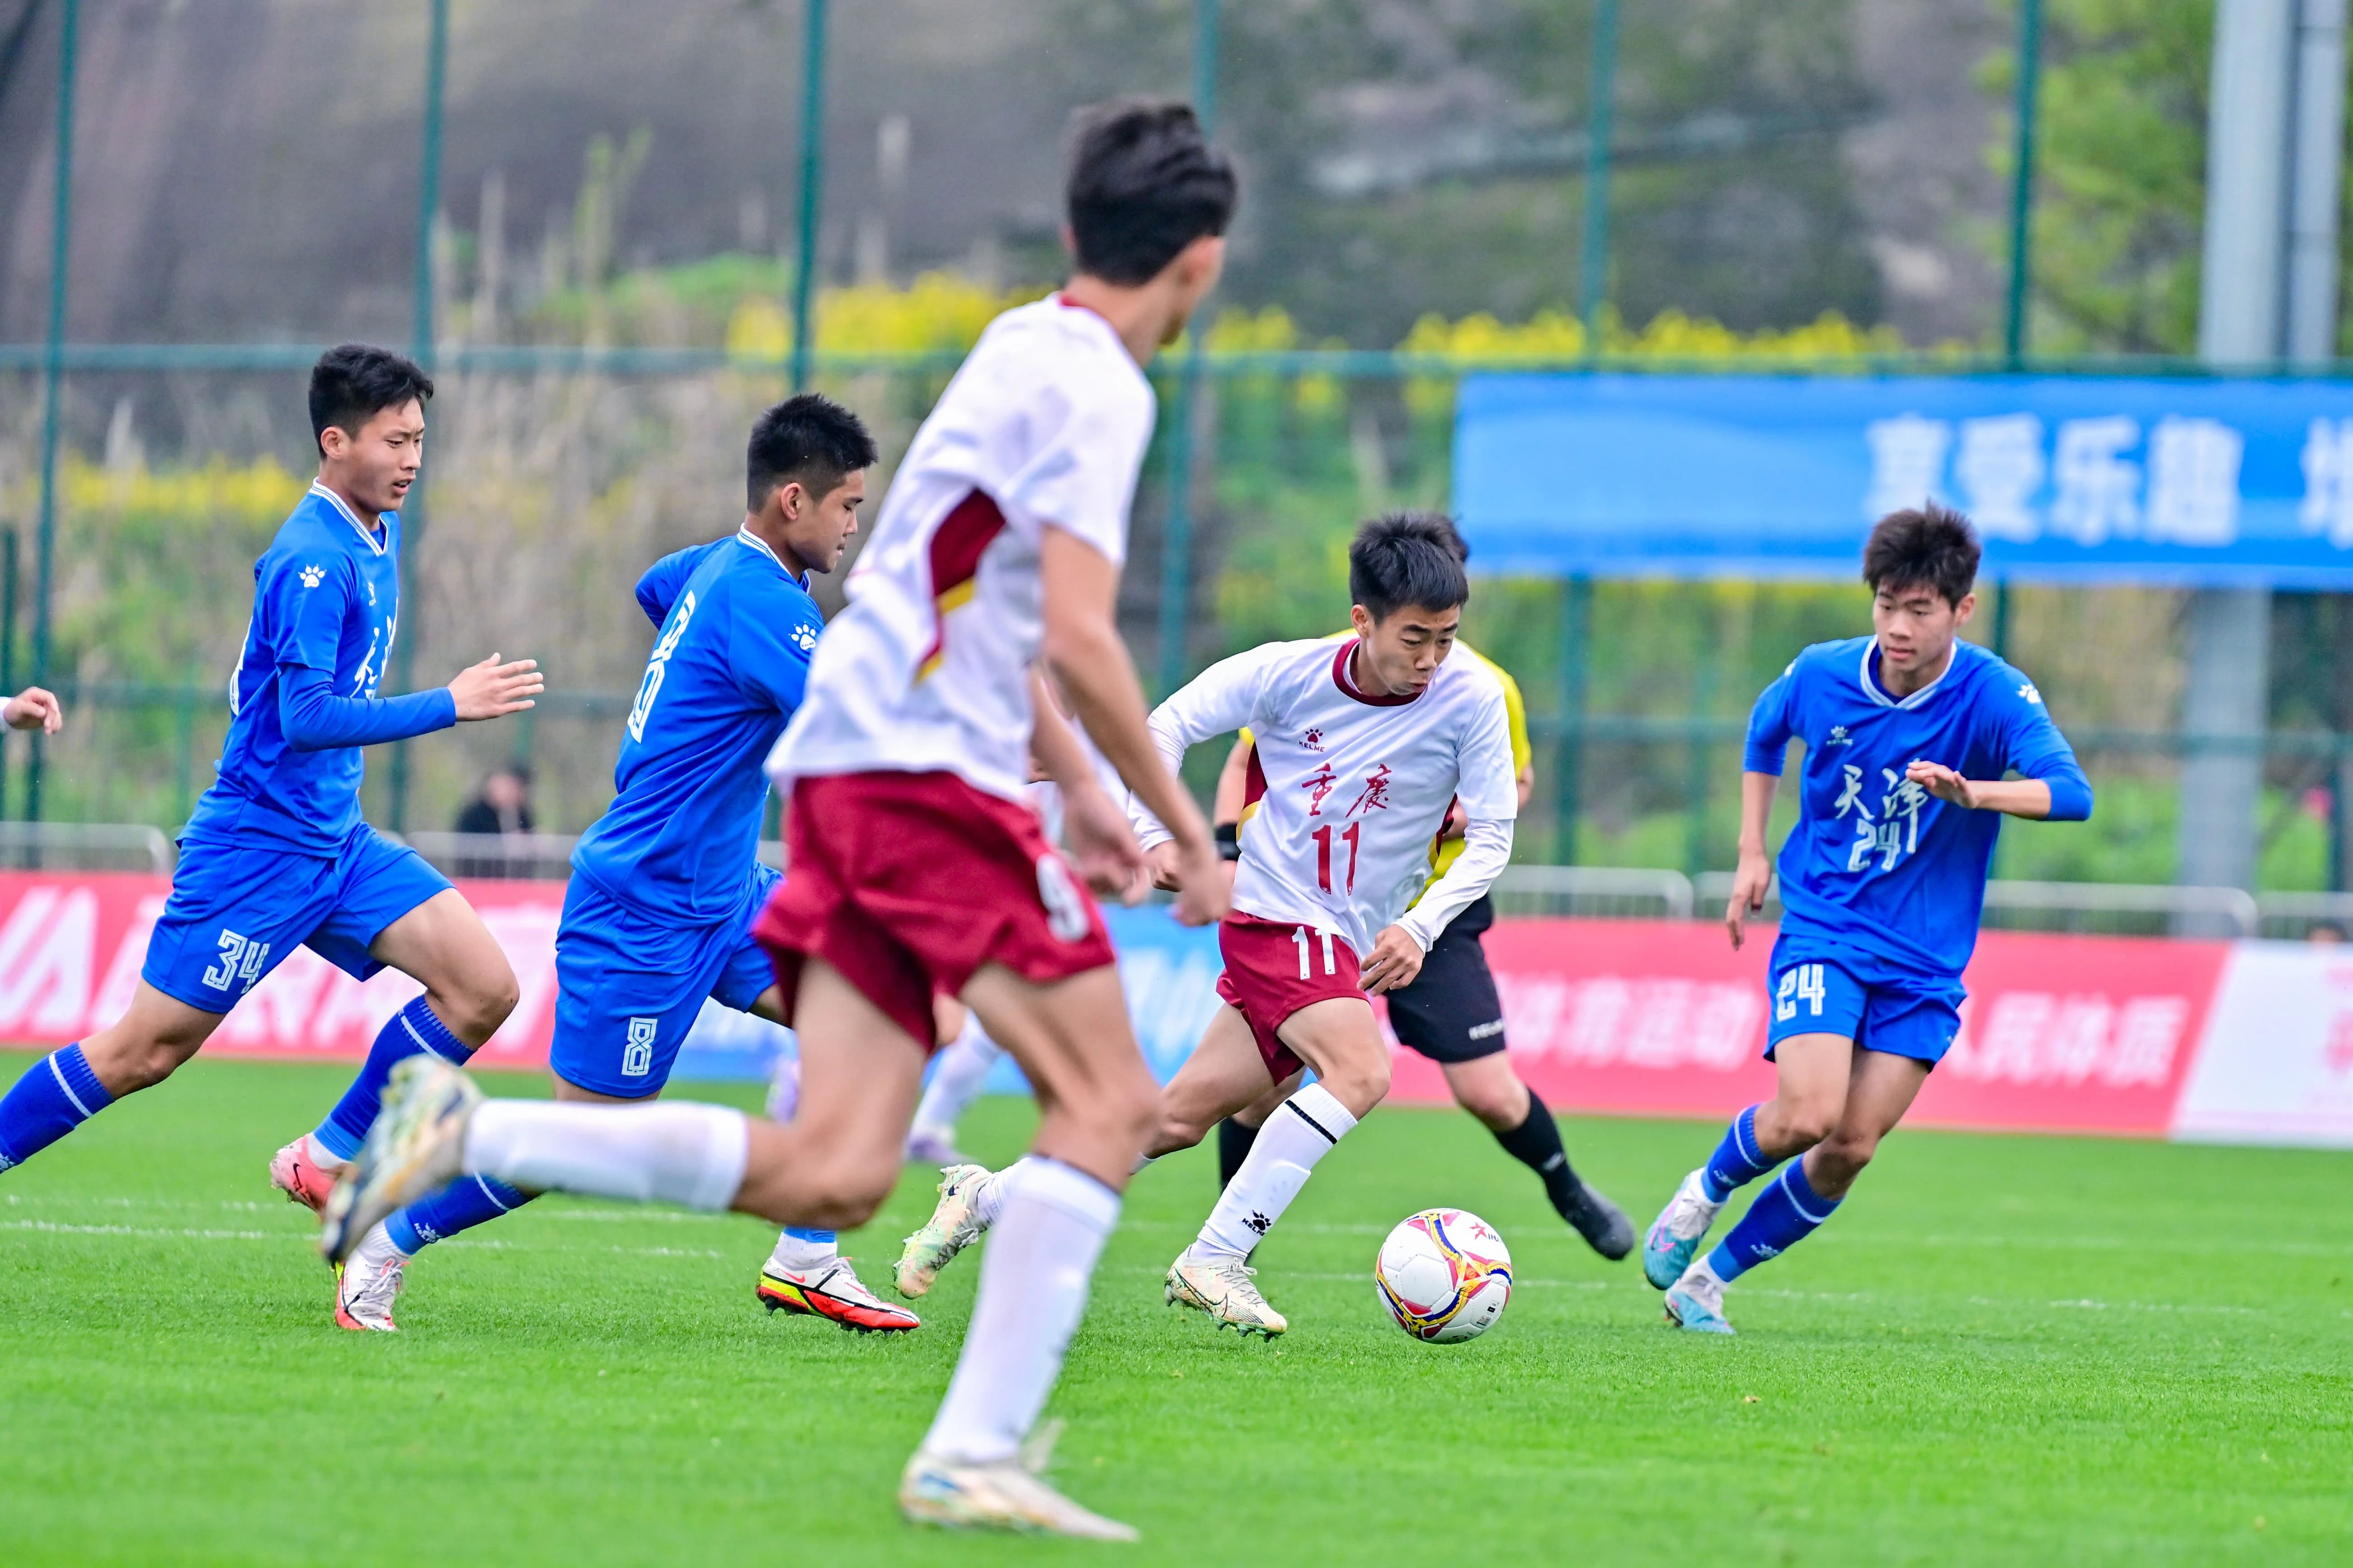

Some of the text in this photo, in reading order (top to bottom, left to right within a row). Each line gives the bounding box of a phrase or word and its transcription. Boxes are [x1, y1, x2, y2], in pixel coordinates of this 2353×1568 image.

[1299, 740, 1325, 752] KELME
[1834, 758, 1929, 854] 天津
[1312, 821, 1360, 896] 11
[1847, 818, 1901, 873] 24
[202, 928, 270, 994] 34
[1292, 925, 1335, 980] 11
[1776, 963, 1826, 1022] 24
[621, 1017, 658, 1076] 8
